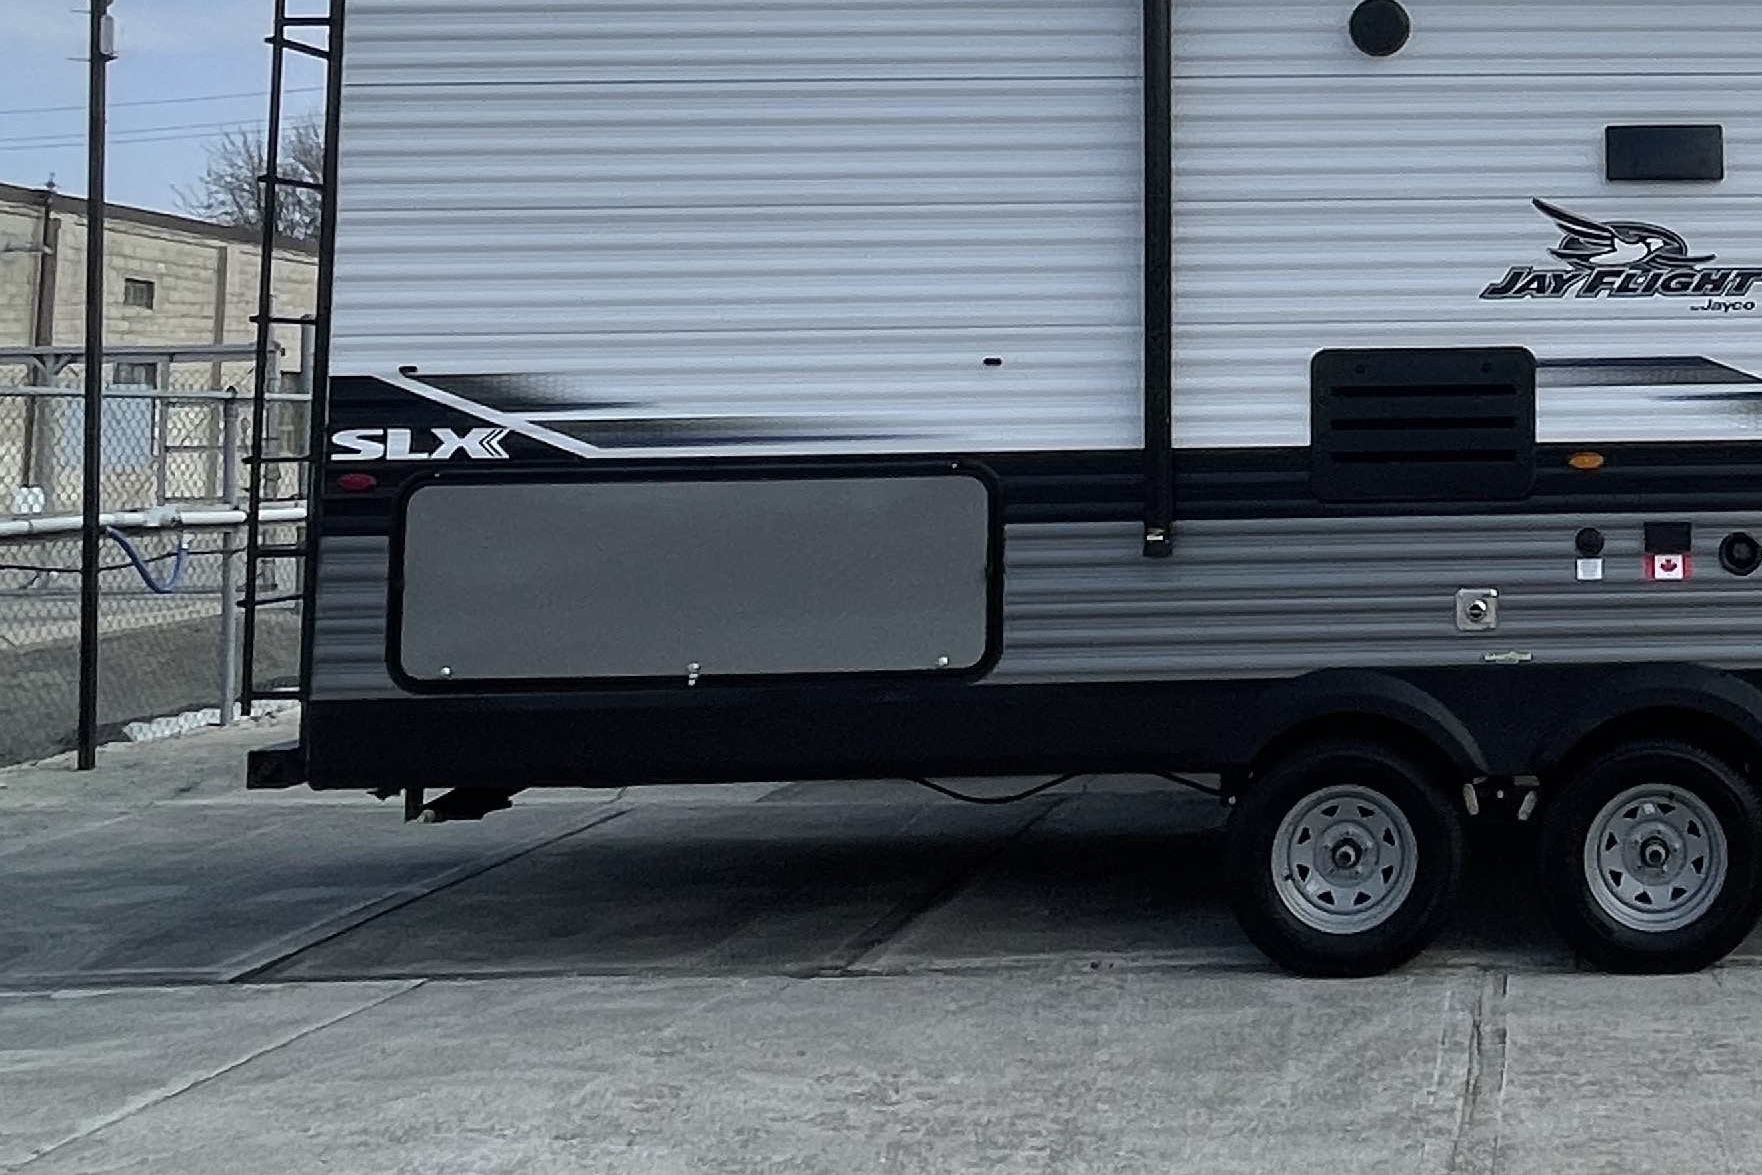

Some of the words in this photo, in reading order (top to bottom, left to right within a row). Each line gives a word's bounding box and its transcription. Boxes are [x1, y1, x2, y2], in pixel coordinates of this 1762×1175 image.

[1480, 265, 1590, 299] JAY
[1701, 299, 1756, 313] Jayco
[330, 428, 510, 461] SLX
